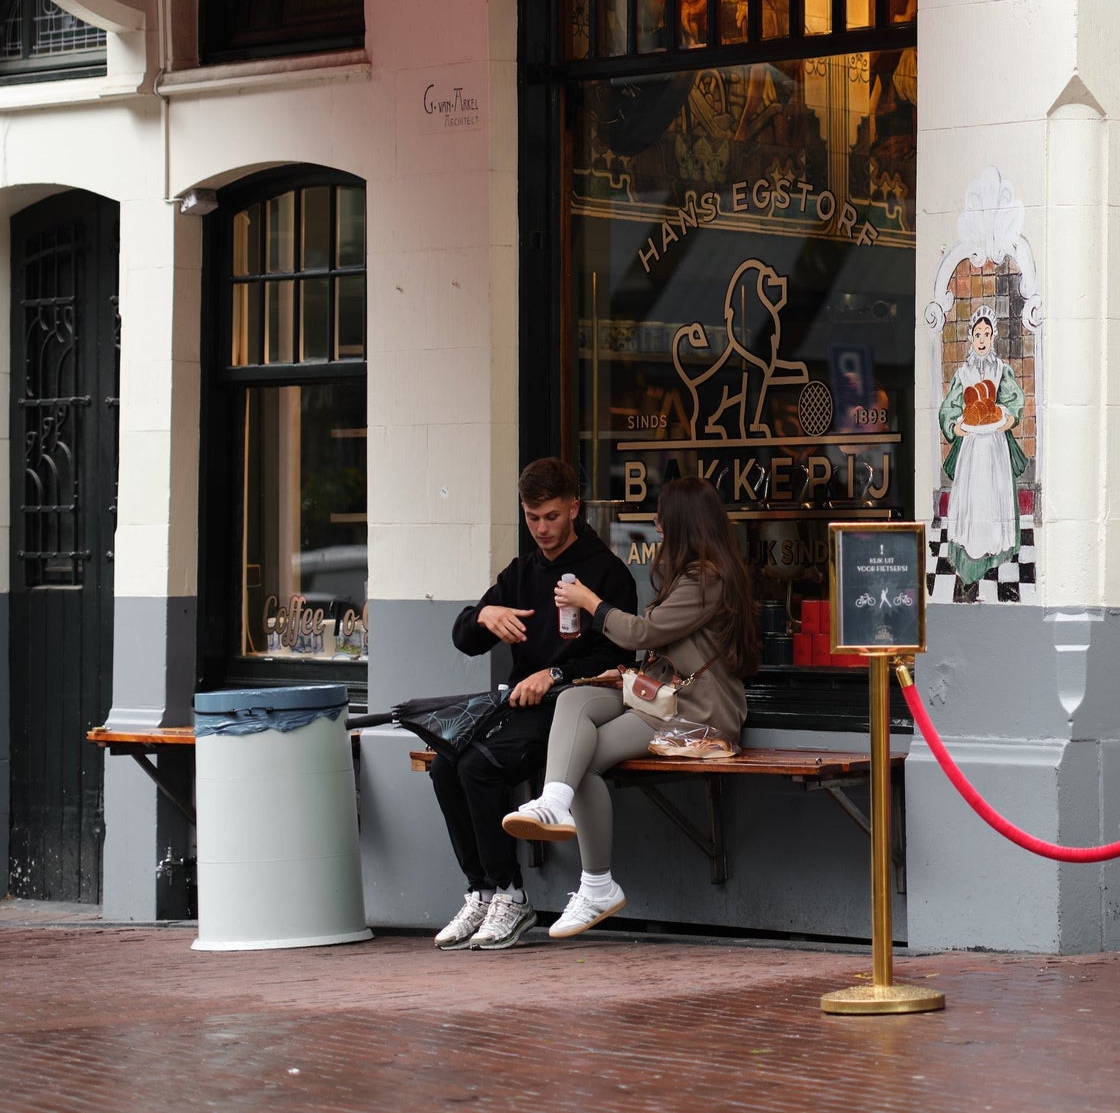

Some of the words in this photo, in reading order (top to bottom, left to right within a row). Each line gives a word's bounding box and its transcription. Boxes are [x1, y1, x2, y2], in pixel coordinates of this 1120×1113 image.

[637, 191, 718, 274] HANS
[732, 178, 881, 248] EGSTORF
[627, 414, 668, 429] SINDS
[854, 407, 888, 424] 1898
[262, 594, 326, 648] Coffee
